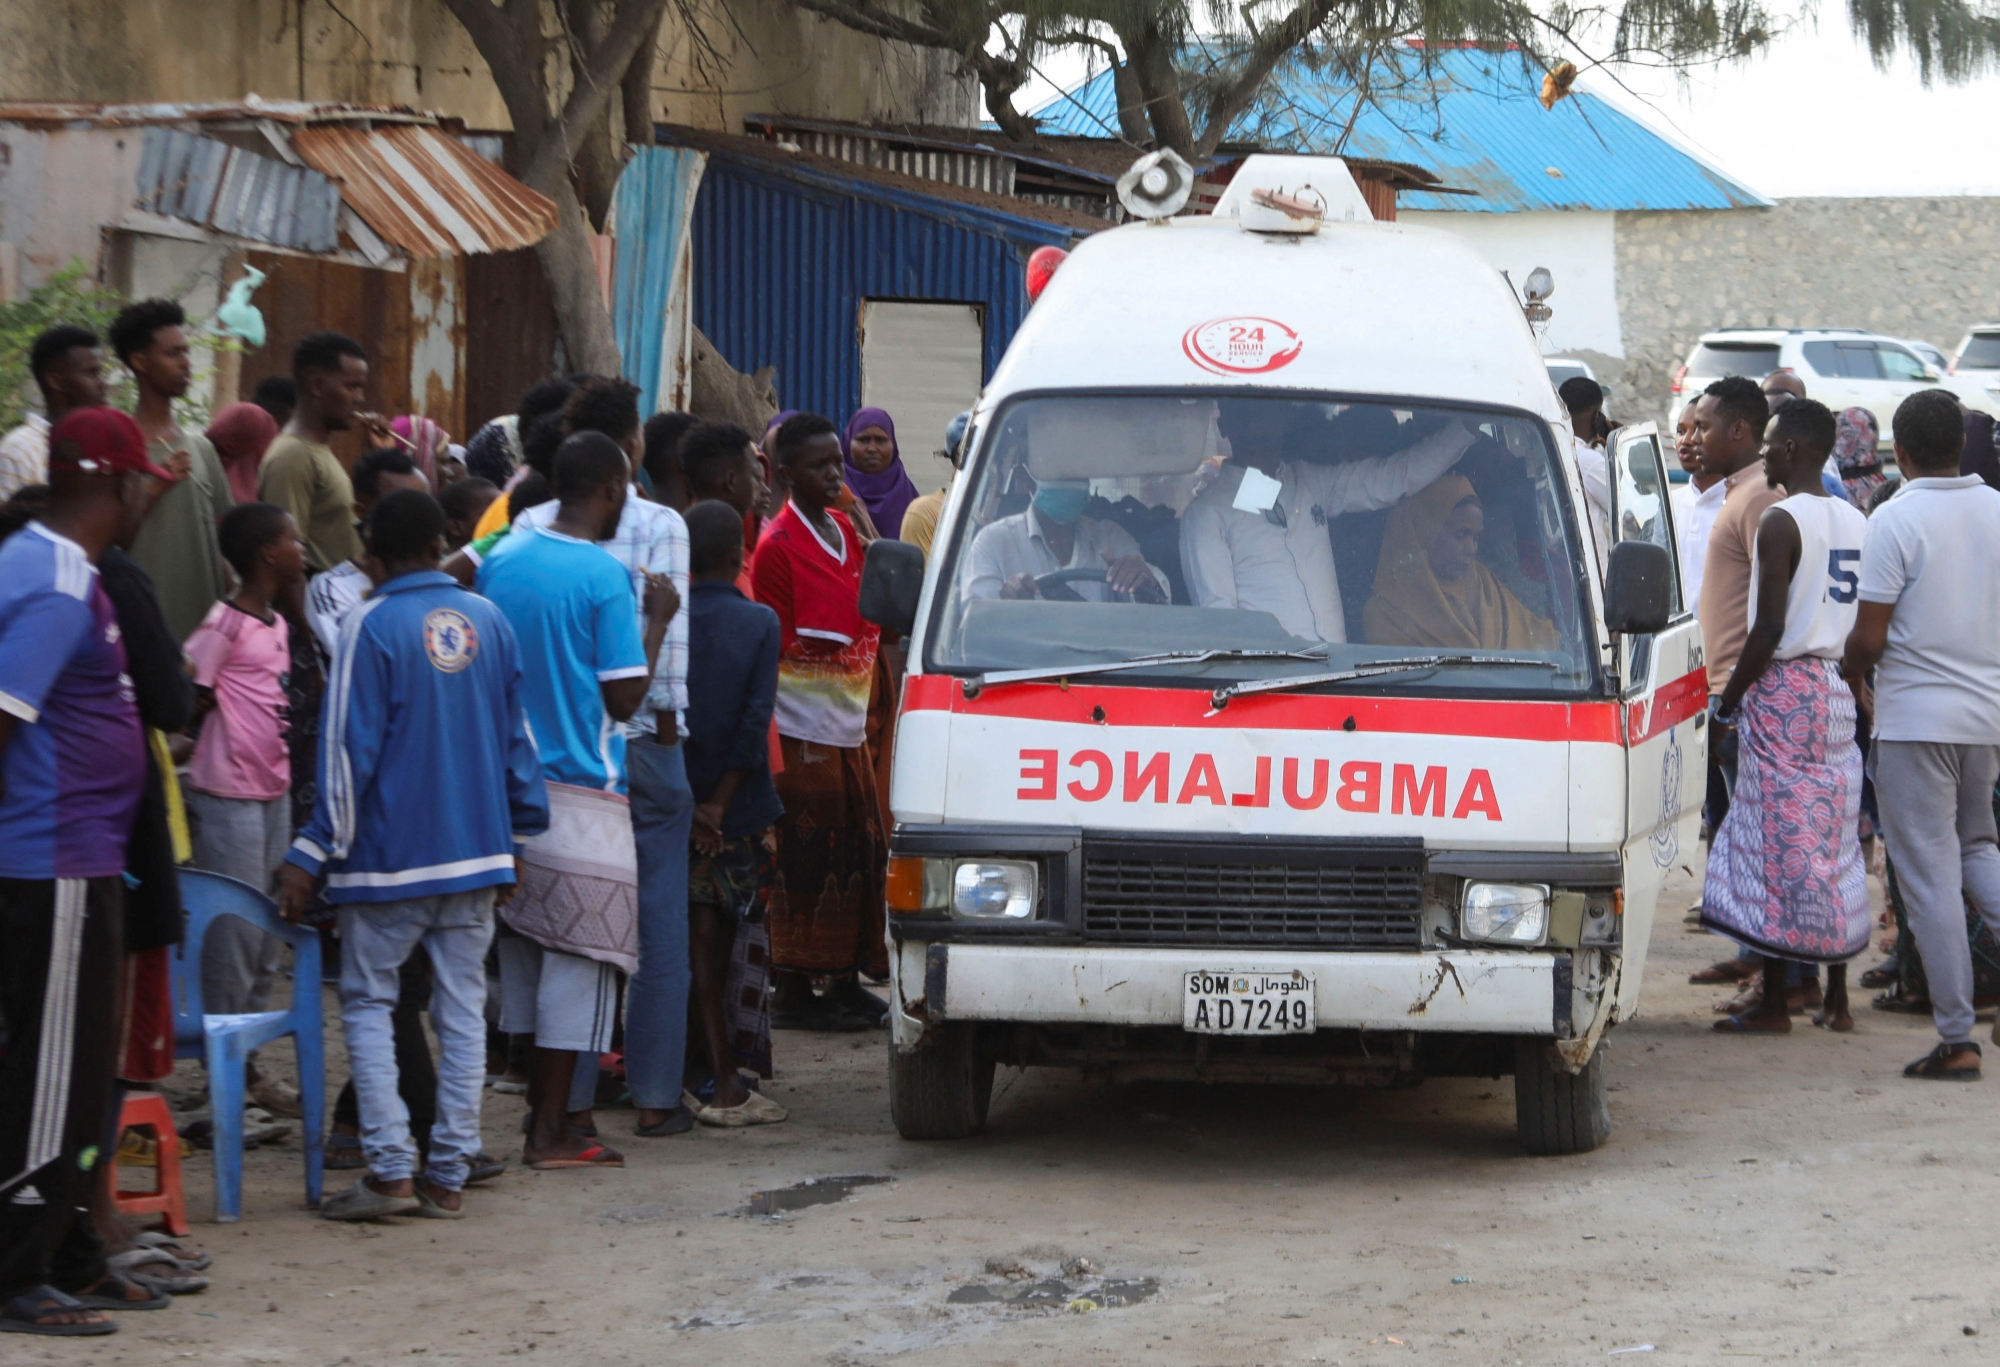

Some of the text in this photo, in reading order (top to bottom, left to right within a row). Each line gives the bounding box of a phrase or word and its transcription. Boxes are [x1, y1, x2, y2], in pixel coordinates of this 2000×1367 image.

[1228, 326, 1266, 343] 24
[1228, 342, 1264, 351] HOUR
[1189, 975, 1229, 995] SOM
